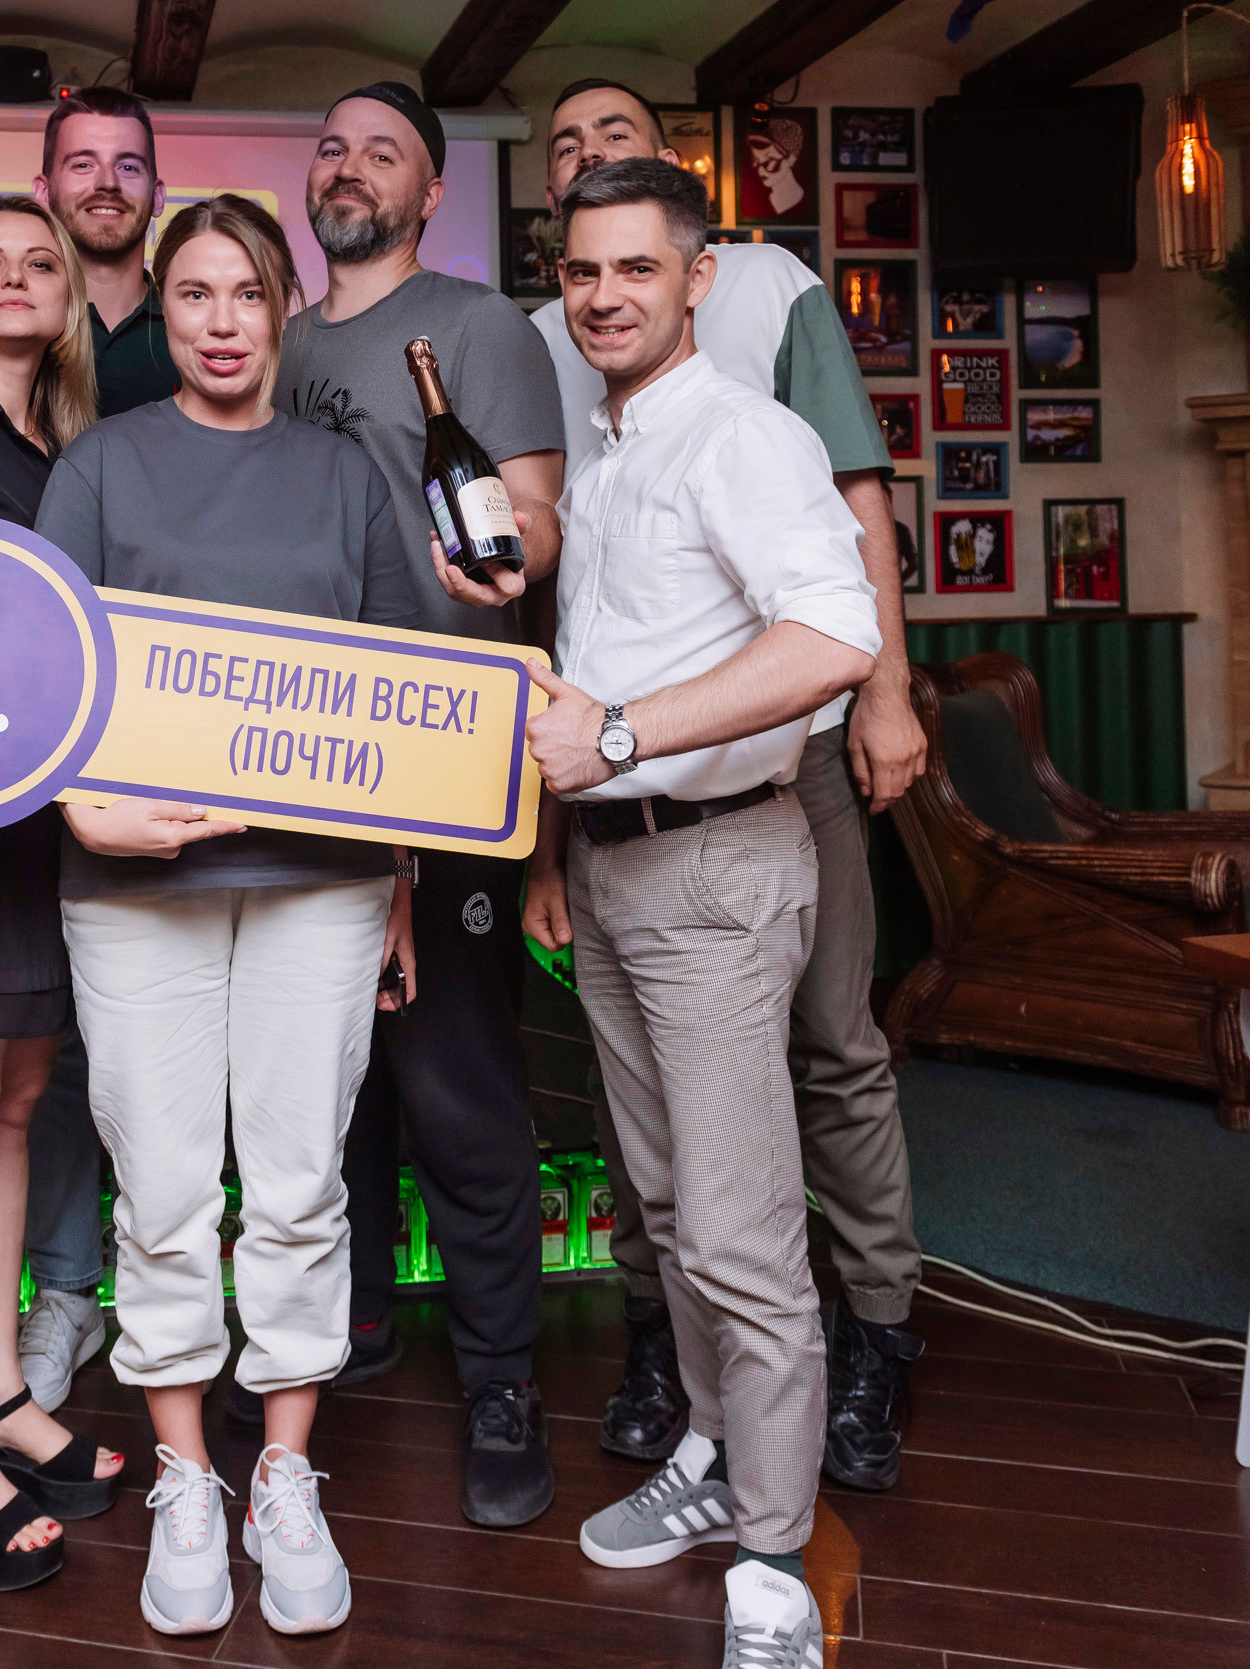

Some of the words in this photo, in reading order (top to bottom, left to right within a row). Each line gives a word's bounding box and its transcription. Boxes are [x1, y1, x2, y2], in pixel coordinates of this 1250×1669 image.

[940, 356, 999, 368] DRINK
[940, 369, 1001, 381] GOOD
[966, 382, 1000, 393] BEER
[956, 574, 970, 585] got
[972, 573, 994, 584] beer?
[144, 644, 358, 718] ПОБЕДИЛИ
[369, 676, 479, 735] ВСЕХ!
[229, 723, 384, 795] (ПОЧТИ)
[762, 1579, 791, 1597] adidas
